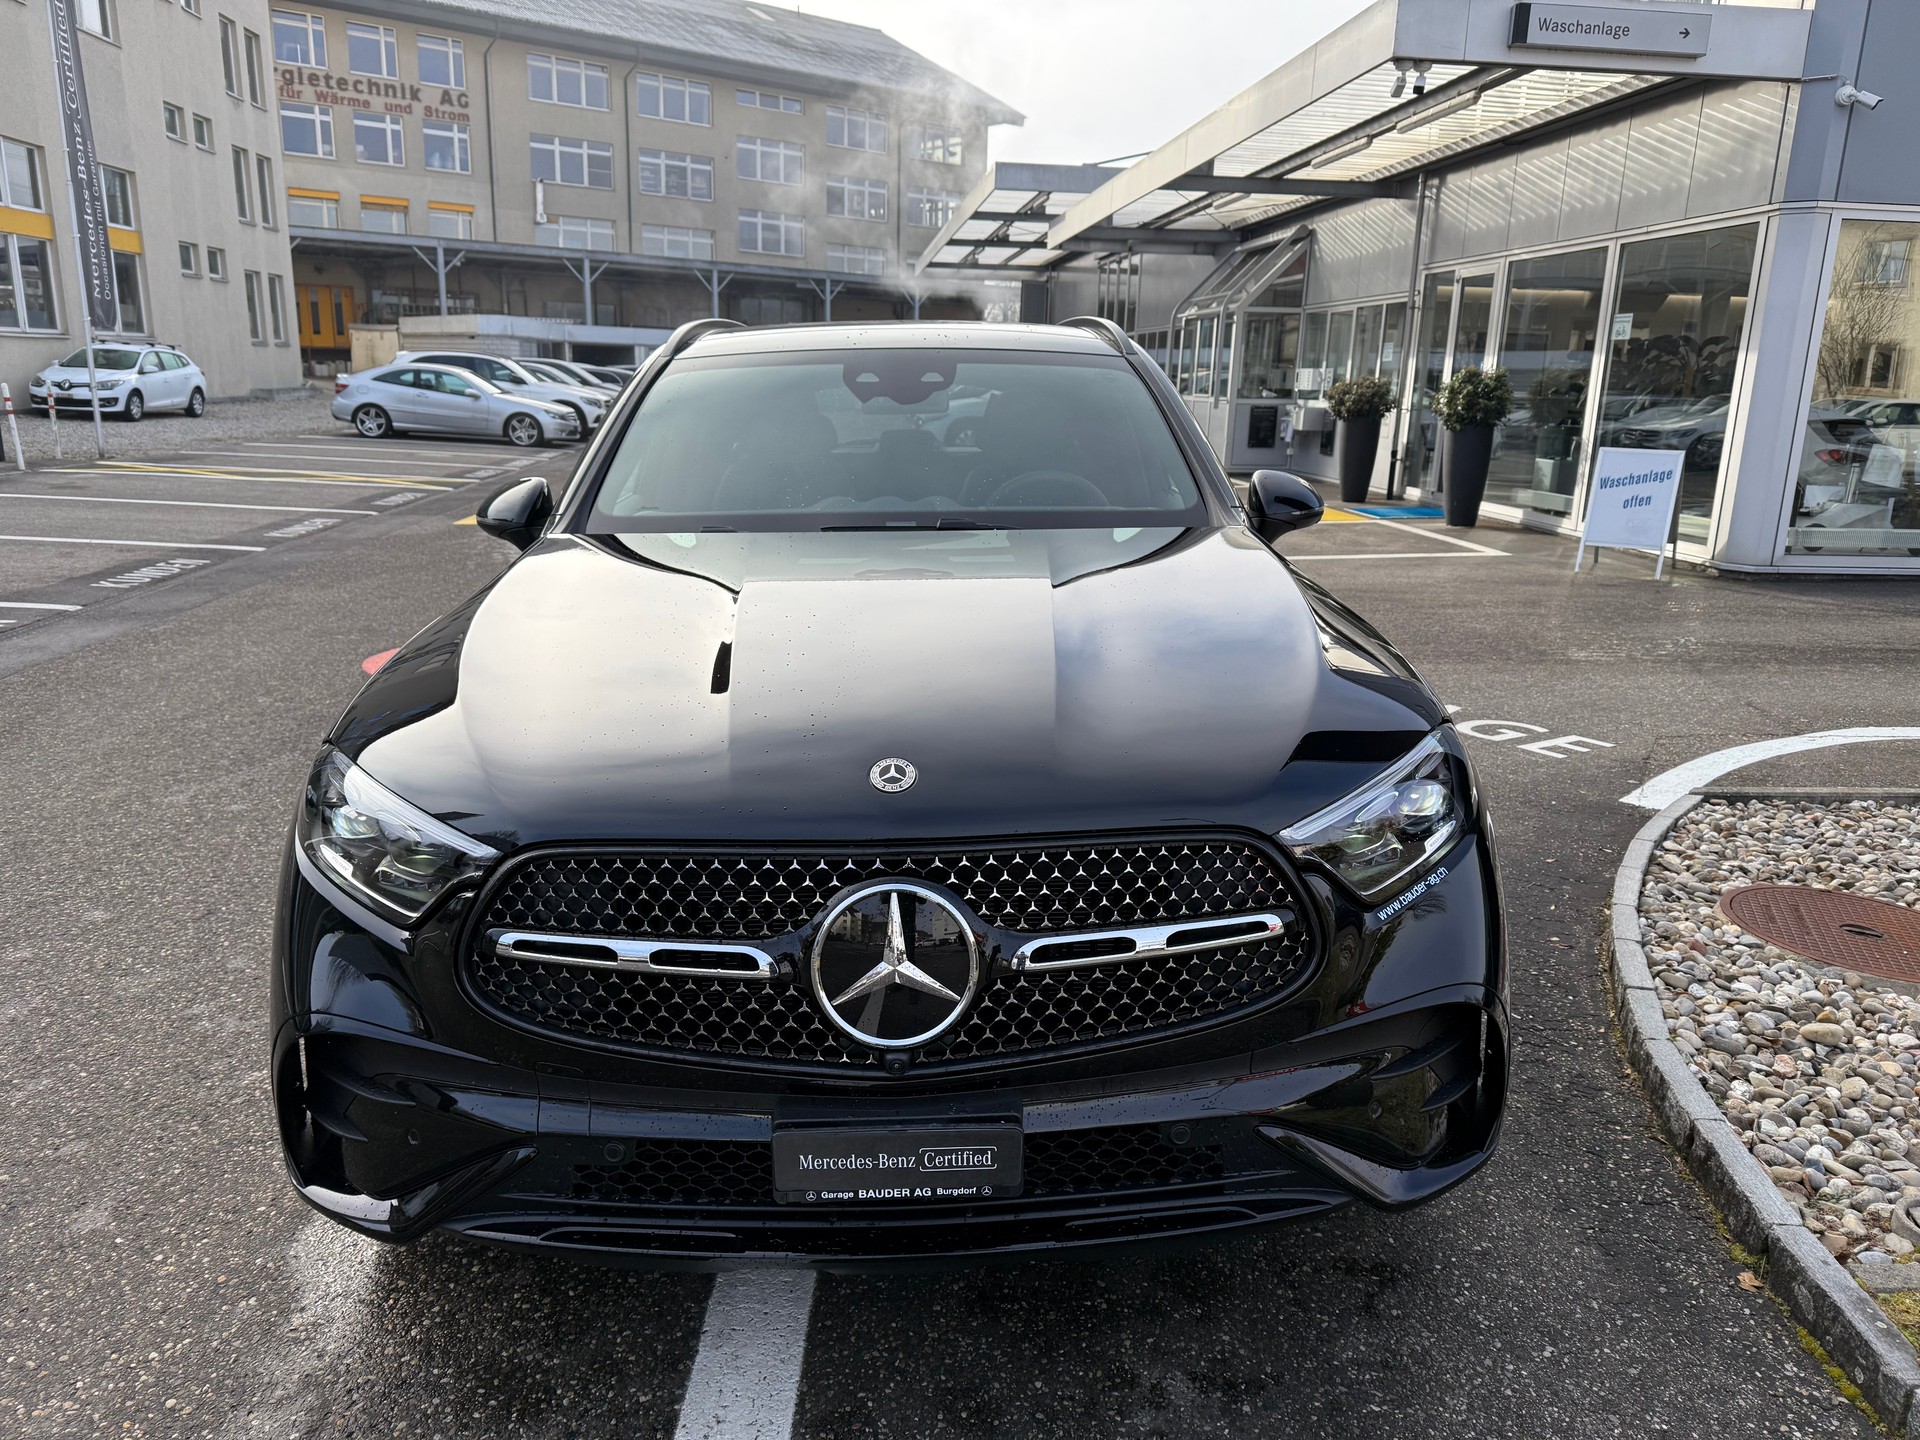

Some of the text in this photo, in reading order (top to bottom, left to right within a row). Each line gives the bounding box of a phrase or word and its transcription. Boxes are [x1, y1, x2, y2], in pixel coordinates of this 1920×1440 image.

[1538, 16, 1630, 40] Waschanlage
[274, 66, 470, 109] gietechnik AG
[279, 84, 471, 123] für Wärme und Strom
[54, 0, 102, 299] Mercedes-Benz Certified
[86, 140, 112, 300] Occasionen mit Garantie
[1600, 469, 1674, 490] Waschanlage
[1623, 494, 1653, 510] offen
[90, 558, 211, 589] KUNDEN
[1377, 866, 1449, 921] www.bauder-ag.ch
[799, 1151, 992, 1170] Mercedes-Benz Certified
[821, 1187, 977, 1200] Garage BAUDER AG Burgdorf
